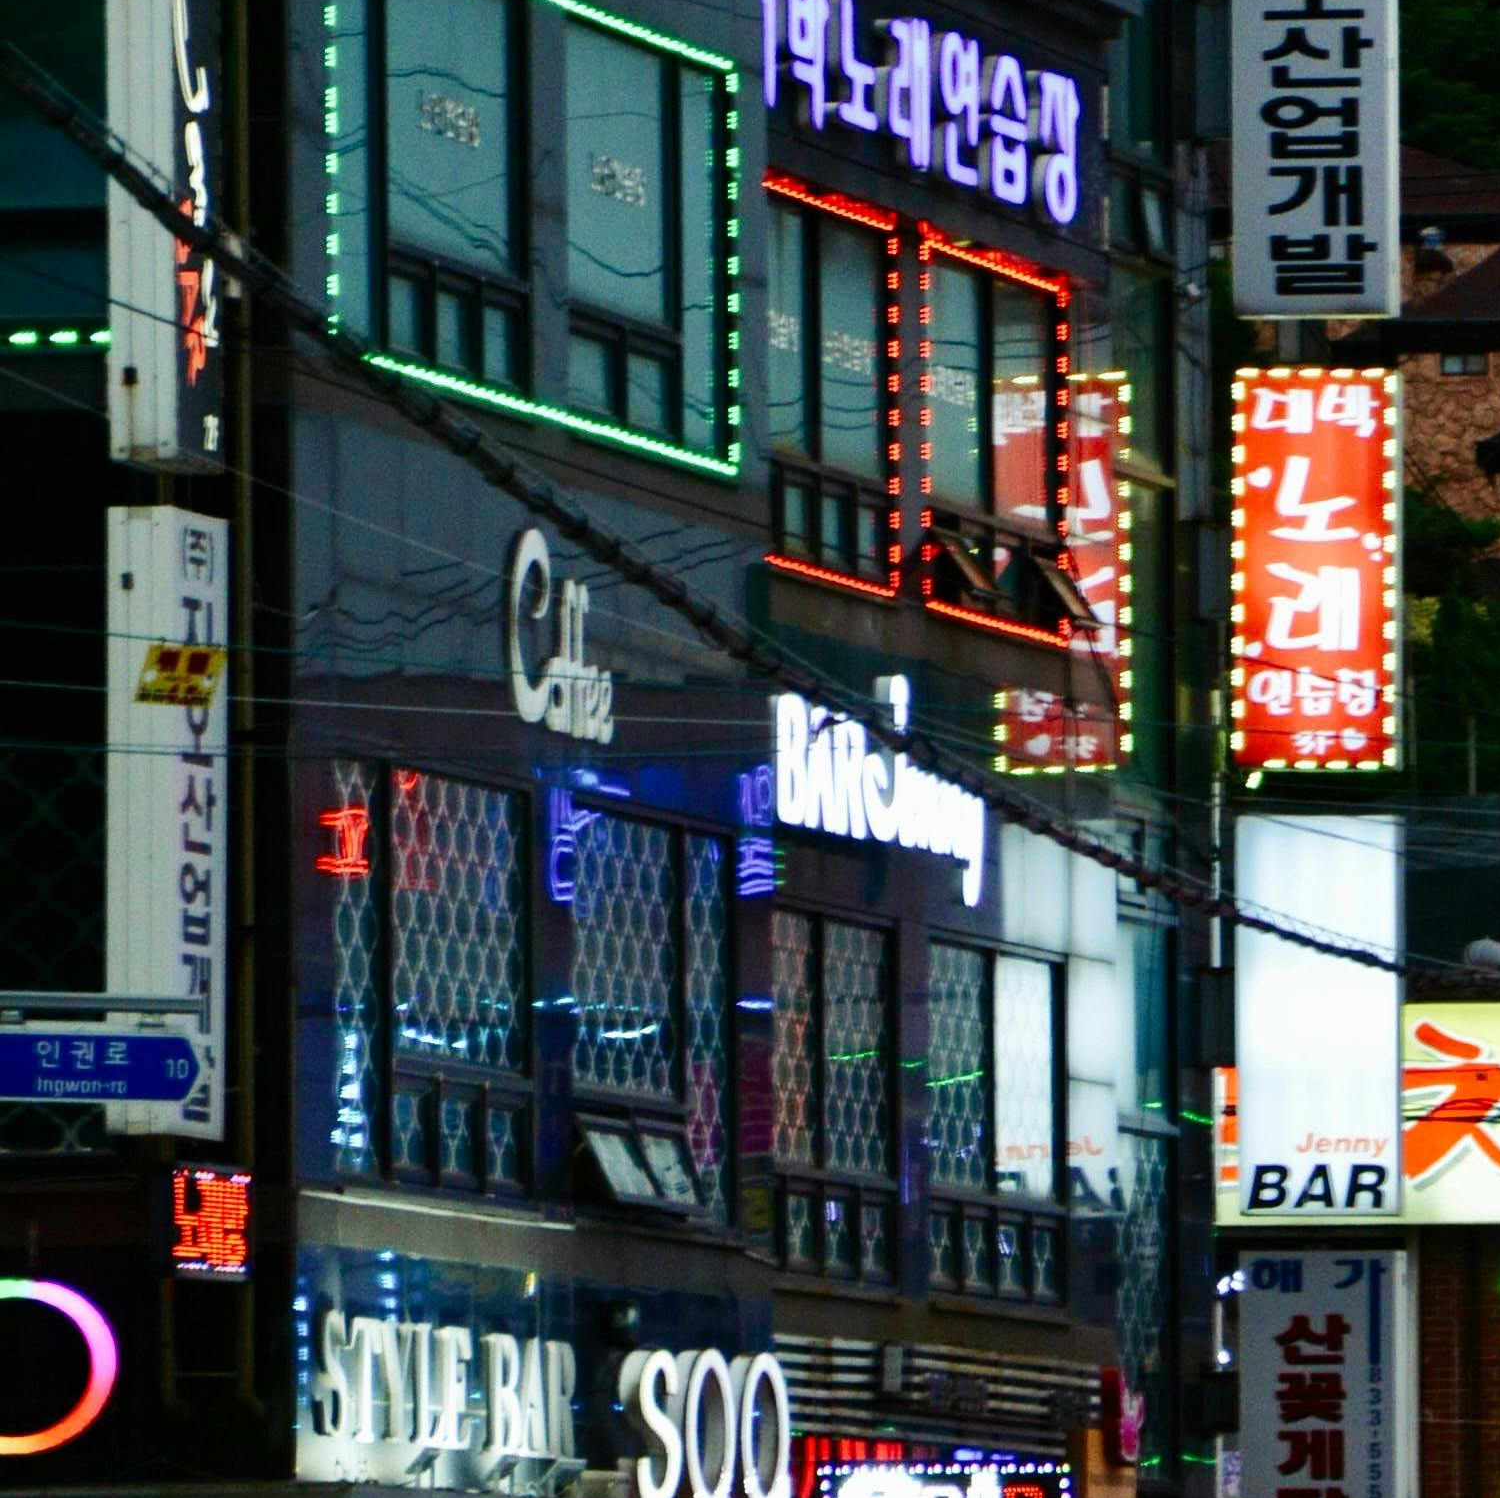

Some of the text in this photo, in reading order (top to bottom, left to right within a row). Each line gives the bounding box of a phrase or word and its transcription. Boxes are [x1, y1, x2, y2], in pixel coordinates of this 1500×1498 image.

[1250, 383, 1380, 439] 대박
[1265, 454, 1360, 653] 노래
[1247, 665, 1381, 718] 연습장
[775, 692, 868, 840] BAR
[37, 1041, 129, 1070] 인권로
[166, 1058, 190, 1080] 10
[1295, 1131, 1389, 1158] Jenny
[1247, 1163, 1388, 1210] BAR
[315, 1309, 576, 1459] STYLE BAR
